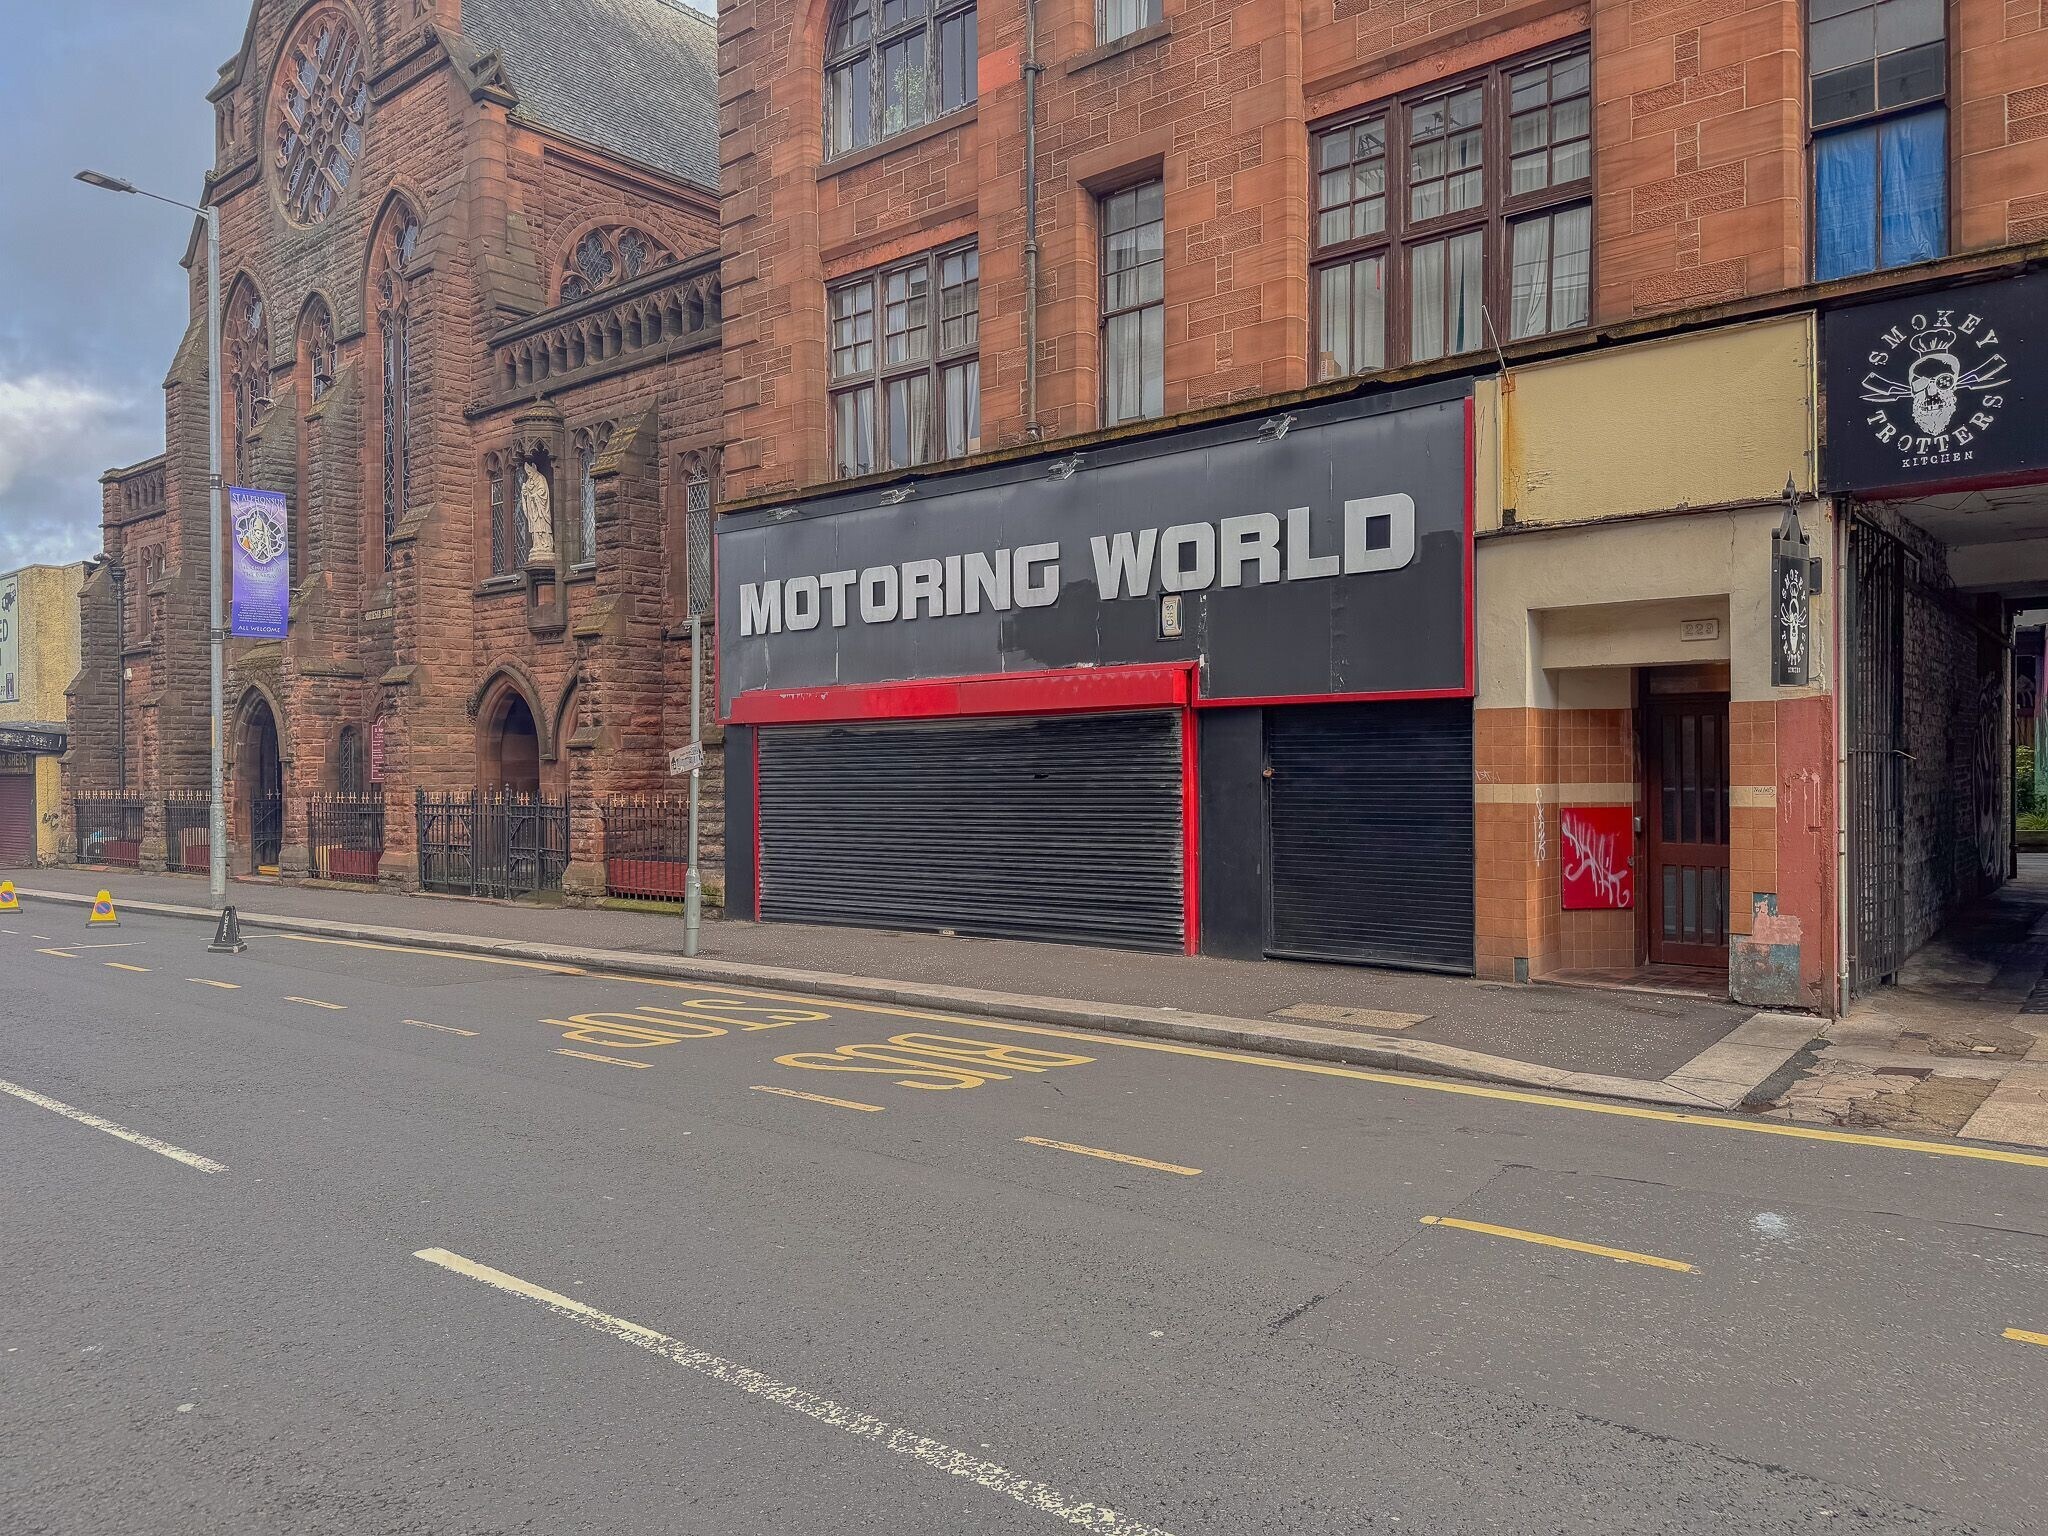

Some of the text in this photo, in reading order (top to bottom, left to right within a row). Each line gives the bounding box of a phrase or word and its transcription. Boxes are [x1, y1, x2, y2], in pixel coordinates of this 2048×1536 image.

[1868, 310, 1999, 366] SMOKEY
[1867, 395, 2004, 455] TROTTERS
[1902, 450, 1974, 468] KITCHEN
[232, 492, 284, 506] ST ALPHONSUS
[739, 492, 1415, 637] MOTORING WORLD
[538, 998, 833, 1048] STOP
[773, 1032, 1099, 1090] BUS
